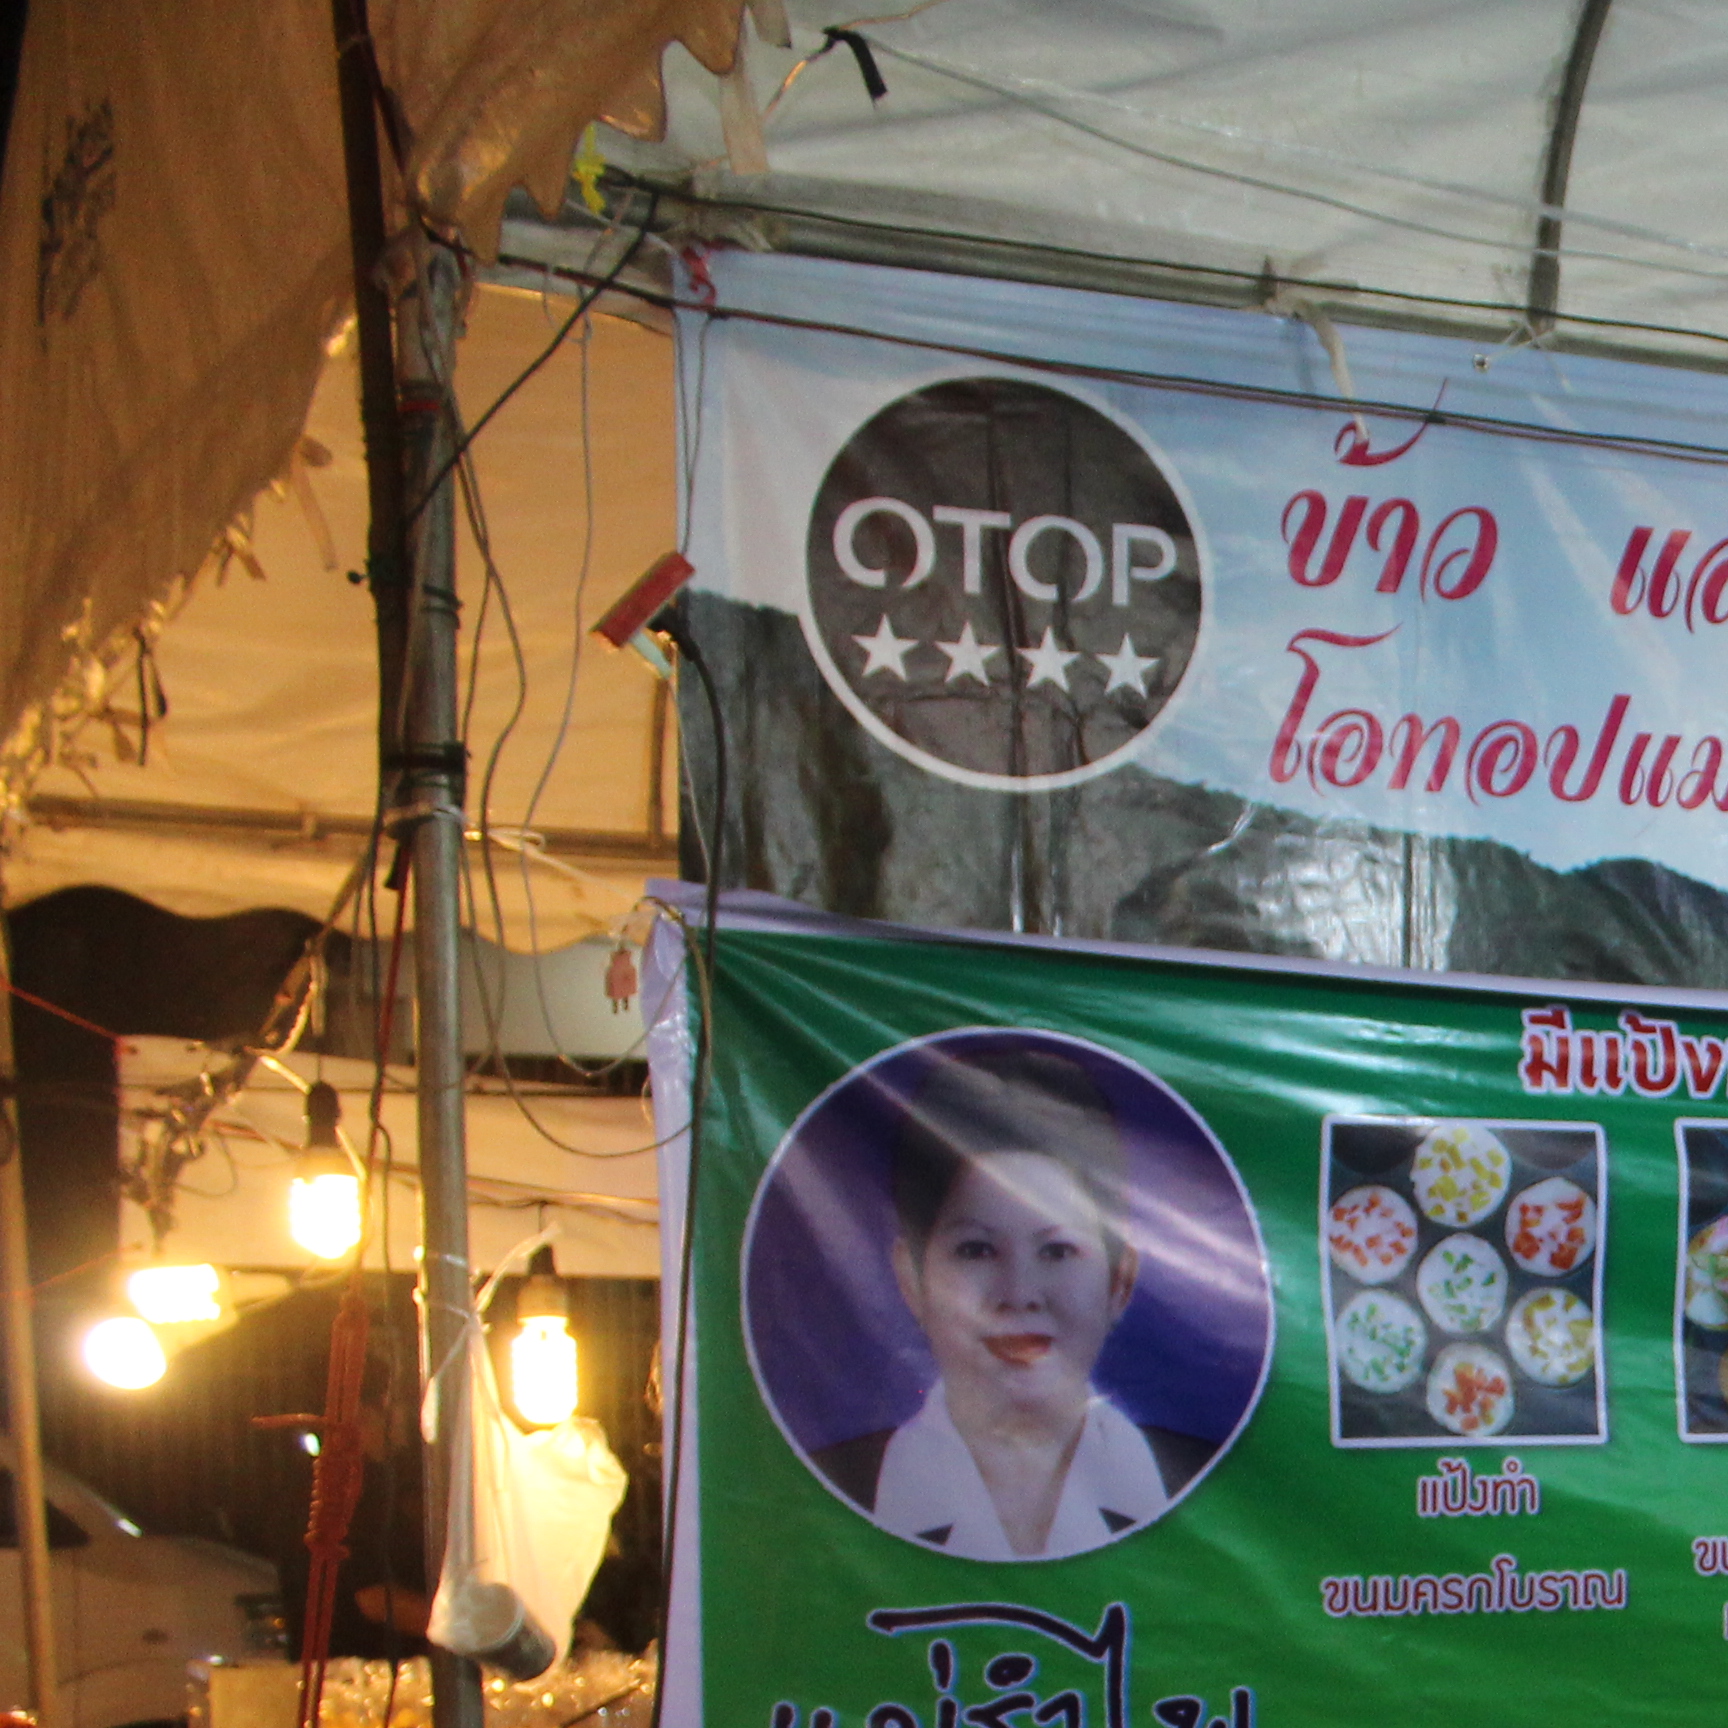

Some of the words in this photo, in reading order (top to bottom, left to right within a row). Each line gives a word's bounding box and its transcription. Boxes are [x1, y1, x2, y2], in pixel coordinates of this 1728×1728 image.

[1281, 378, 1498, 601] ข้าว
[832, 495, 1178, 607] OTOP
[1416, 1456, 1541, 1518] แป้งทำ
[1321, 1554, 1628, 1618] ขนมครกโบราณ
